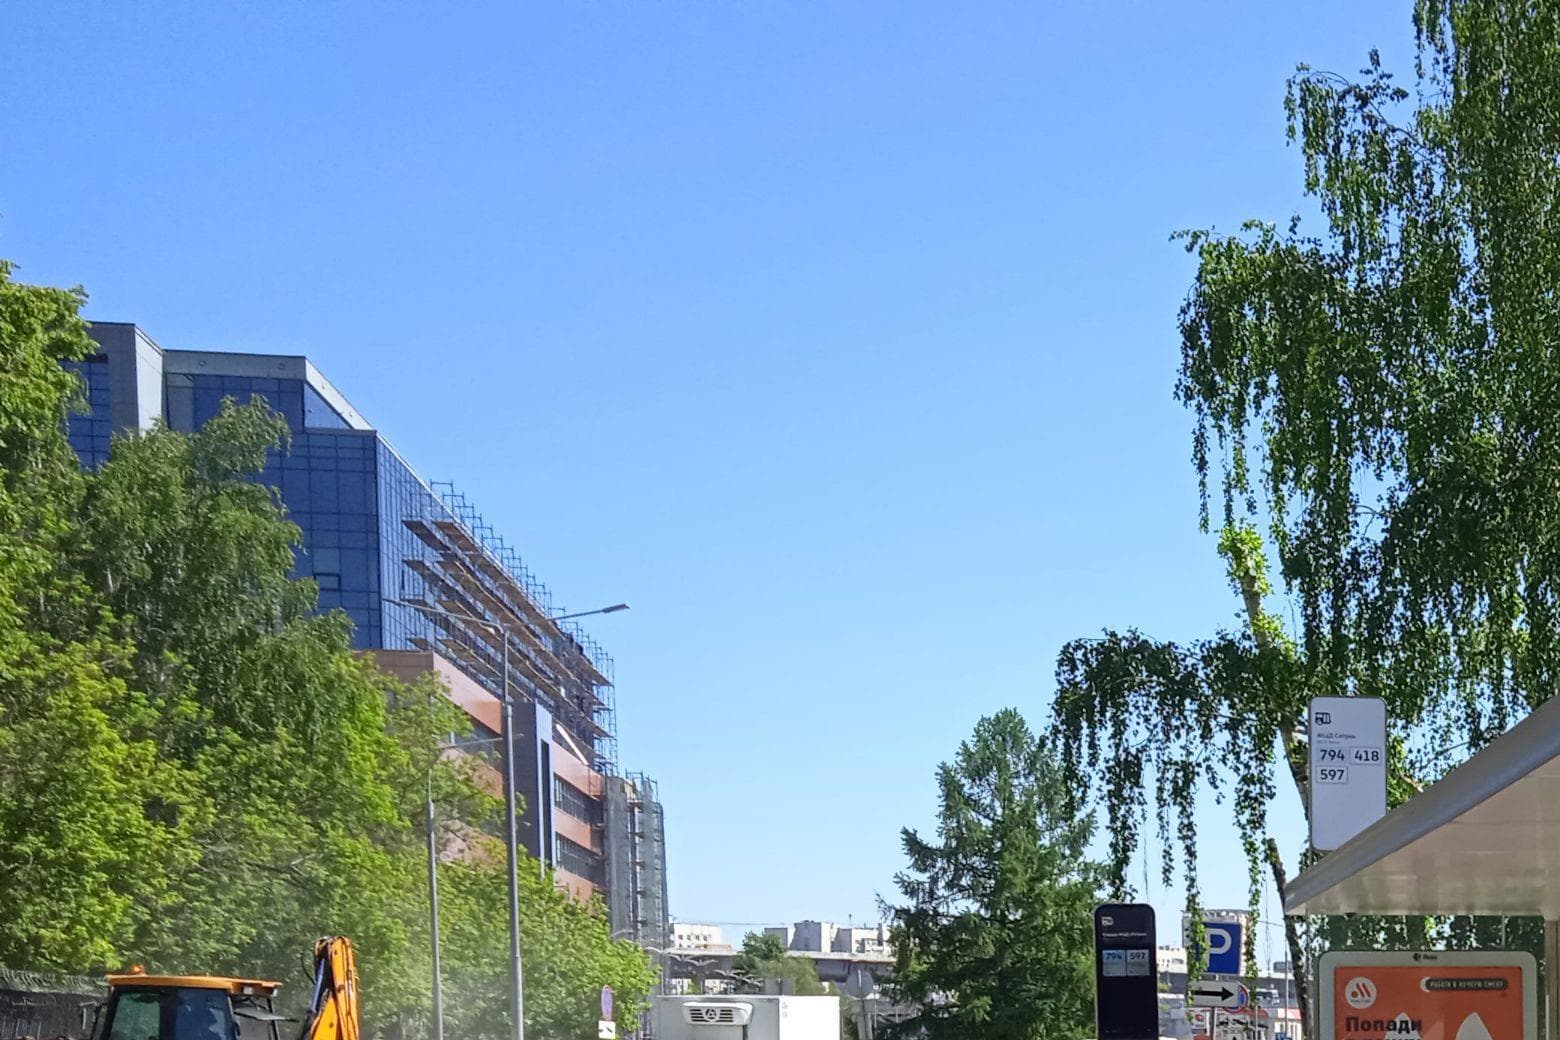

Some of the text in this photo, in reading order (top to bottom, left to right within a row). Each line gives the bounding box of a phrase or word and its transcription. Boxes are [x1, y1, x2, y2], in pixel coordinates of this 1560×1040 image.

[1320, 749, 1380, 761] 794 418
[1320, 769, 1344, 780] 597
[1105, 952, 1146, 960] 794 597
[1346, 1017, 1422, 1034] Попади
